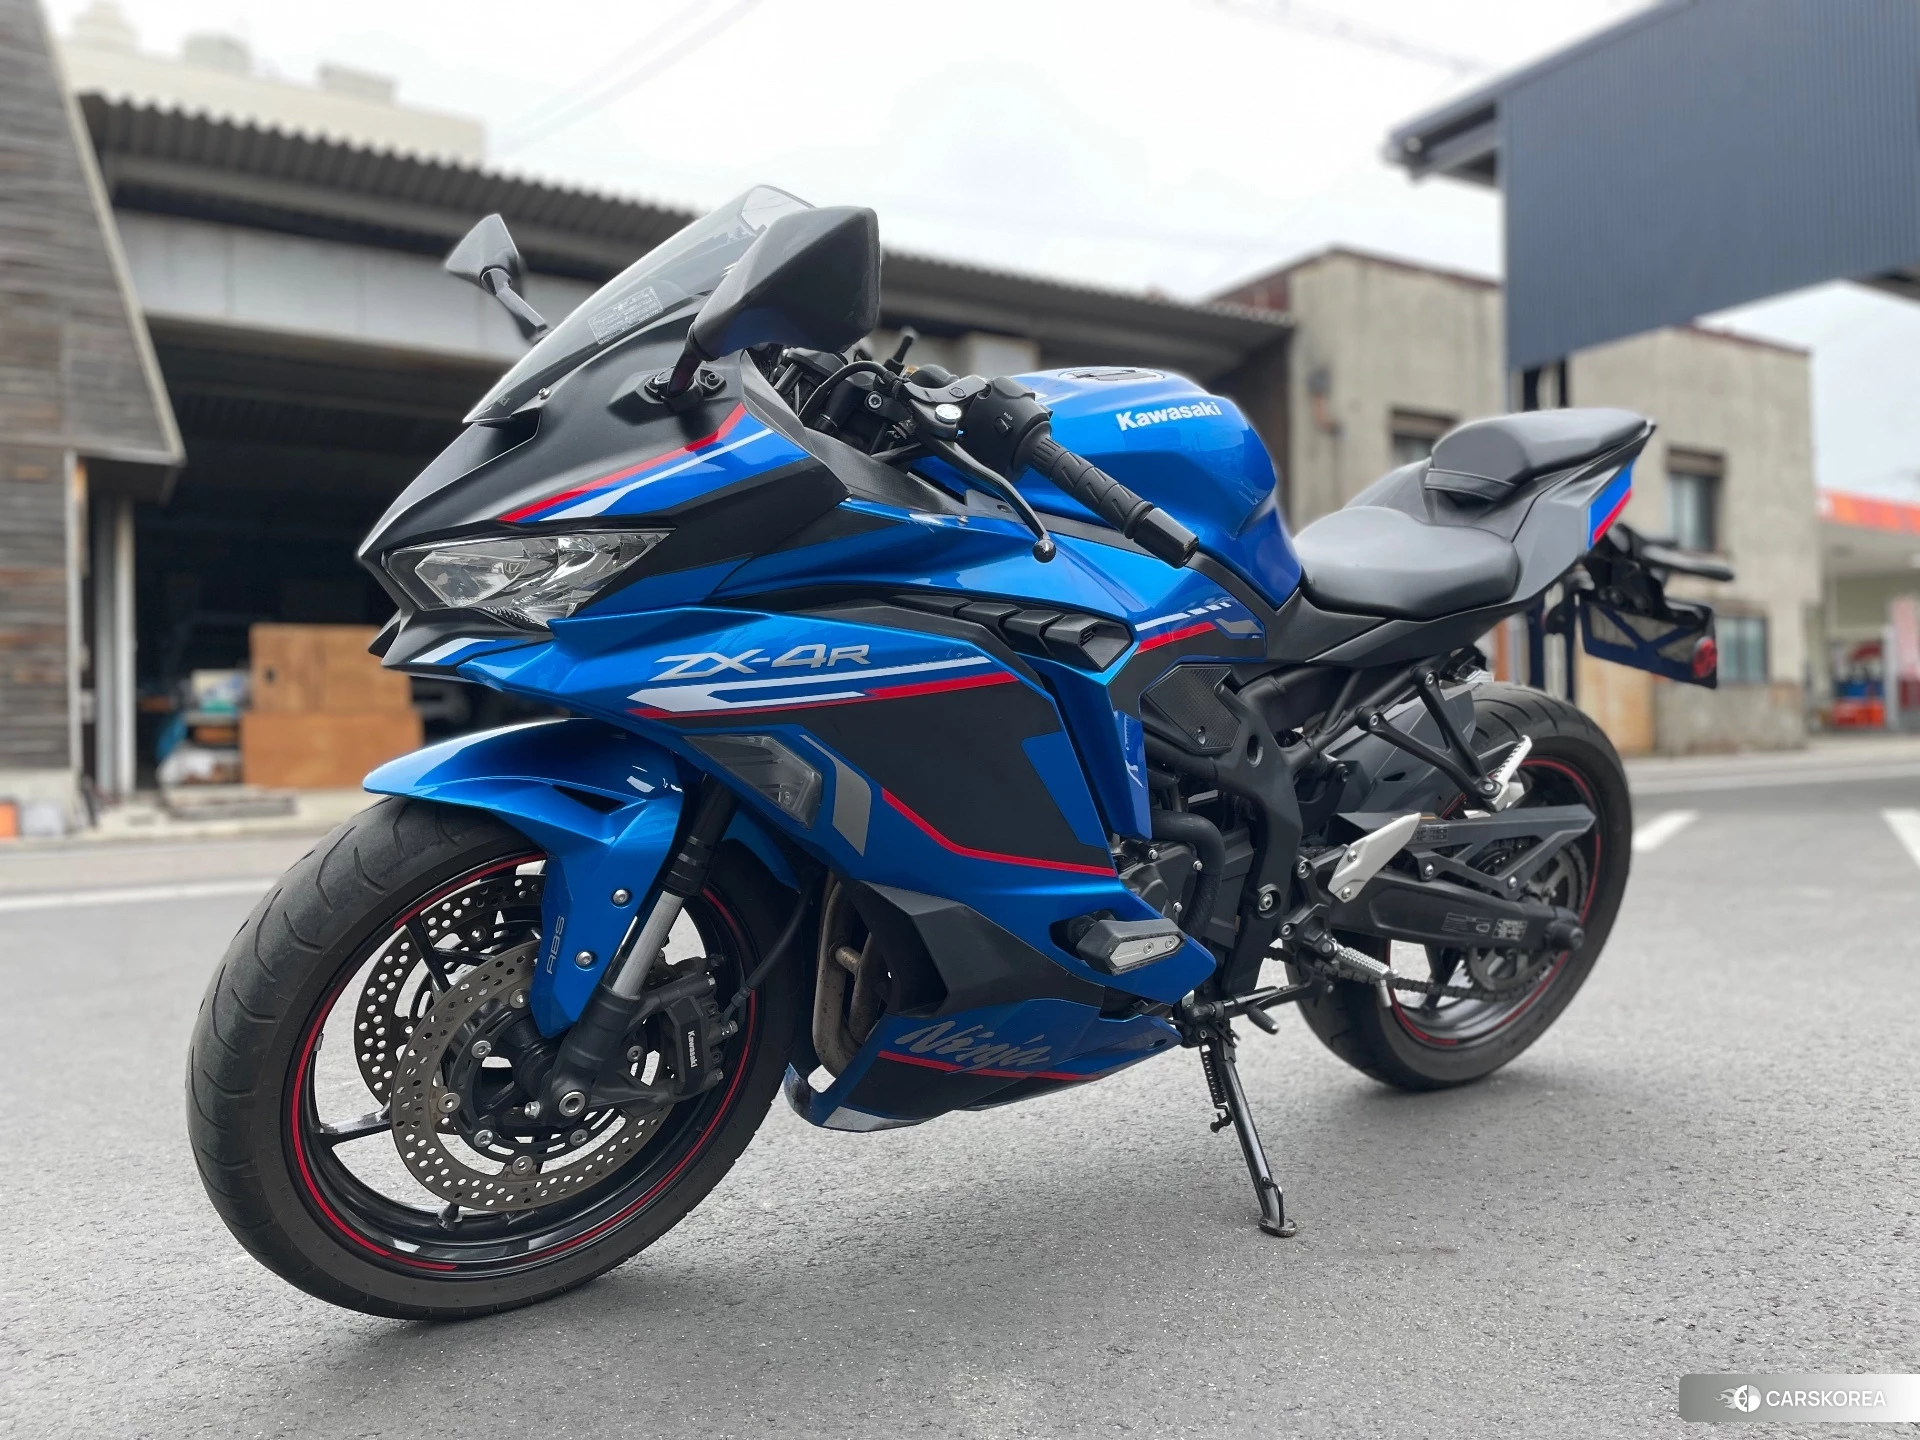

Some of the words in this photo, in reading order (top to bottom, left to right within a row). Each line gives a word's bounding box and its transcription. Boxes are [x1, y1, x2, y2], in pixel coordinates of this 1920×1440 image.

[1115, 401, 1222, 431] Kawasaki
[648, 643, 872, 682] ZX-4R
[546, 915, 565, 975] ABS
[687, 1030, 698, 1068] Kawasaki
[894, 1020, 1052, 1075] Ninja
